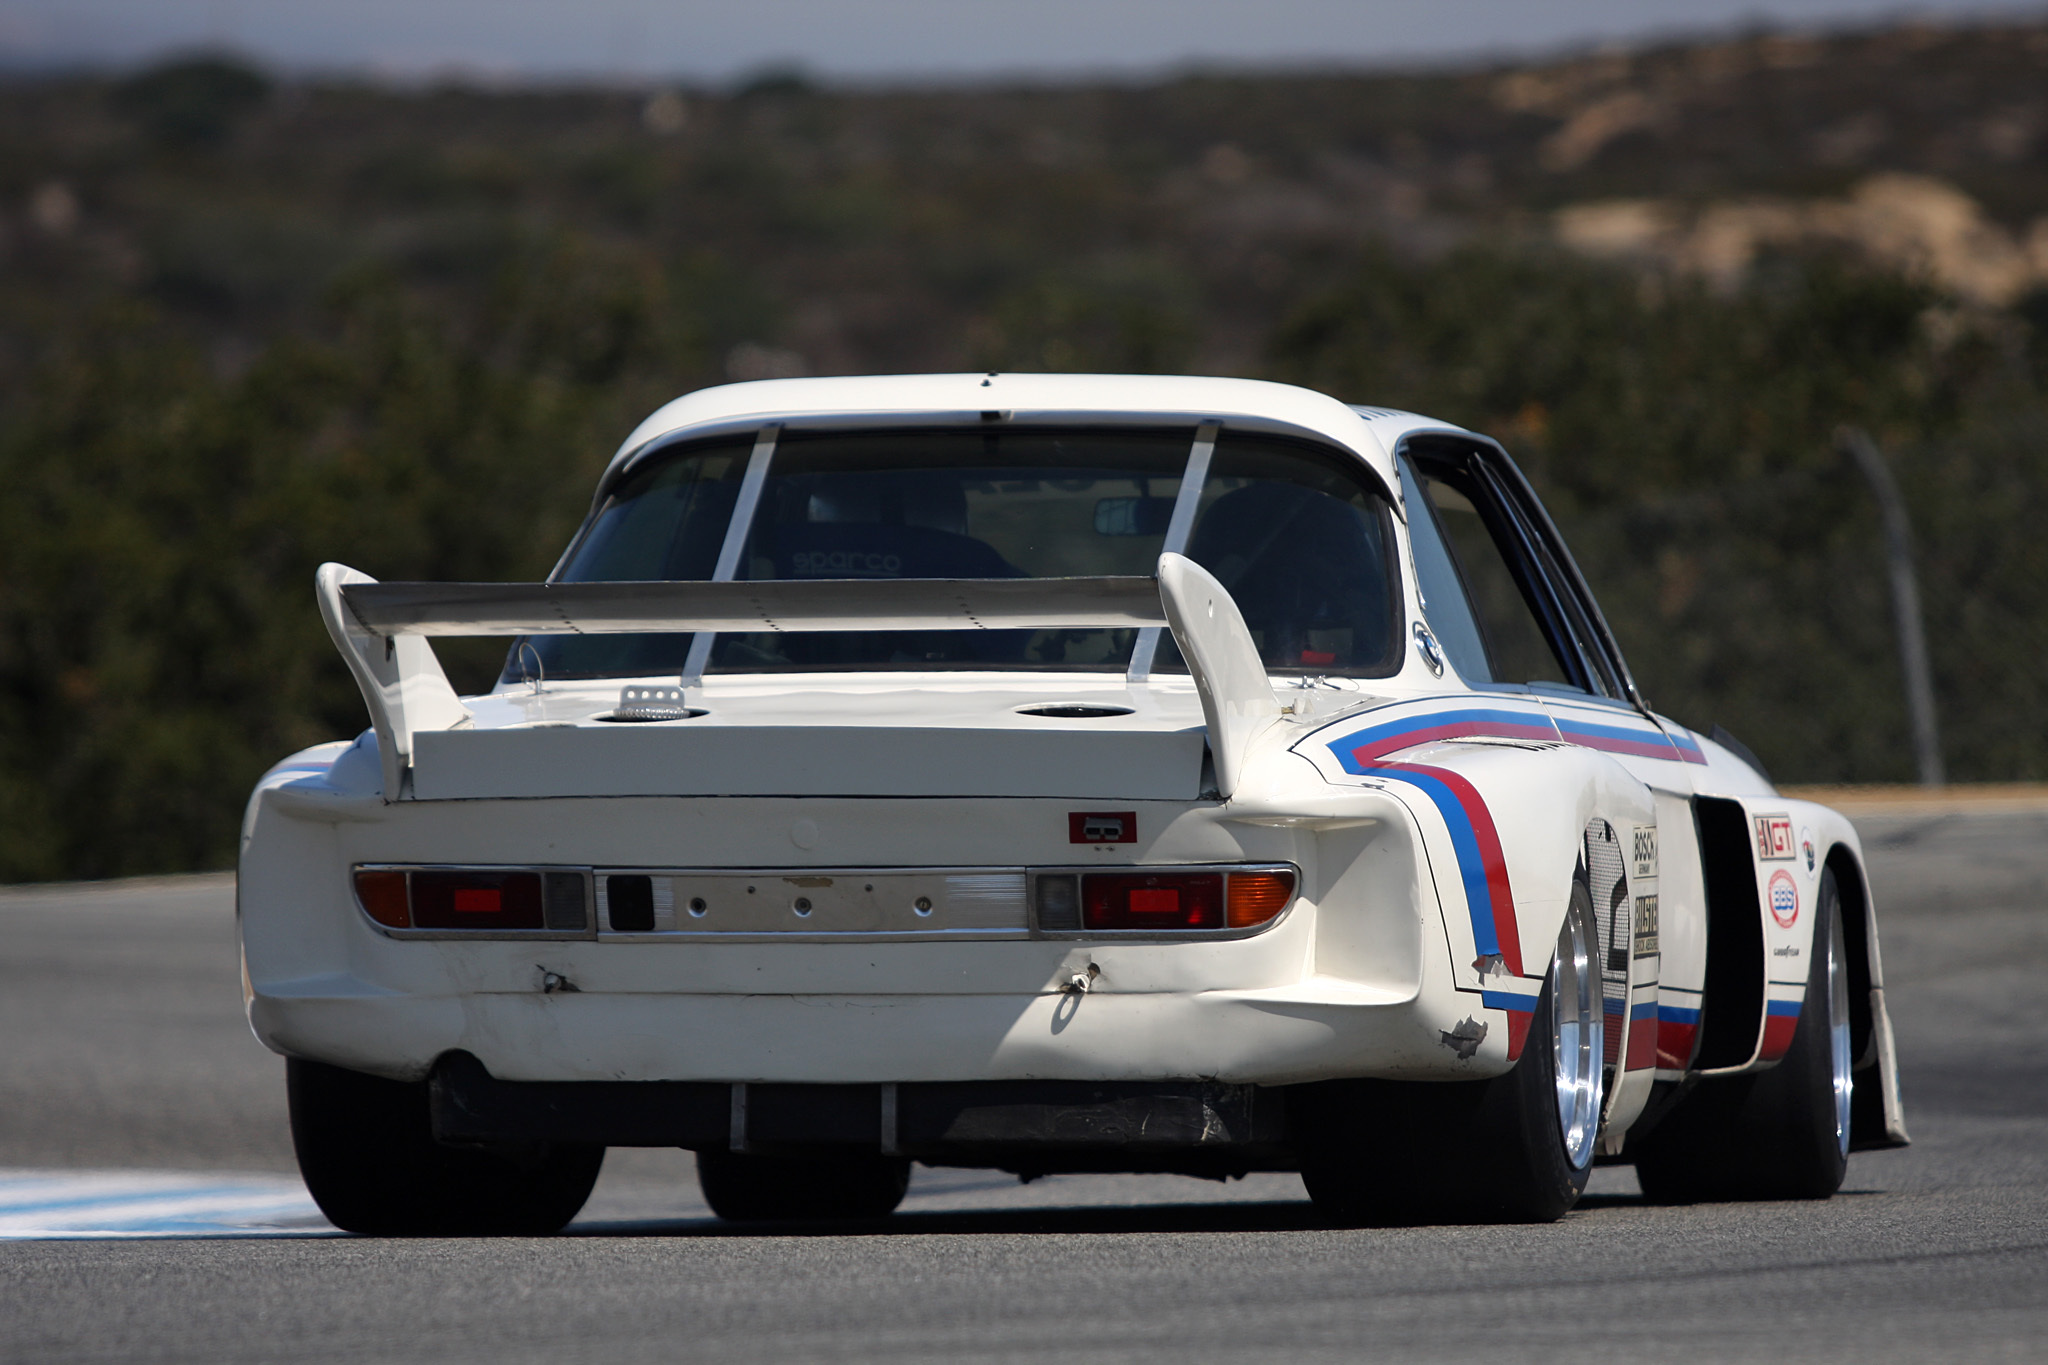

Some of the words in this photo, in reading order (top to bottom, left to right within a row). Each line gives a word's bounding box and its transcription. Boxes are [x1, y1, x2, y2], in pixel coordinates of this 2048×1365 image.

[792, 550, 902, 576] sparco
[1634, 832, 1655, 861] BOSCH
[1771, 822, 1791, 851] GT
[1774, 886, 1794, 911] BBS
